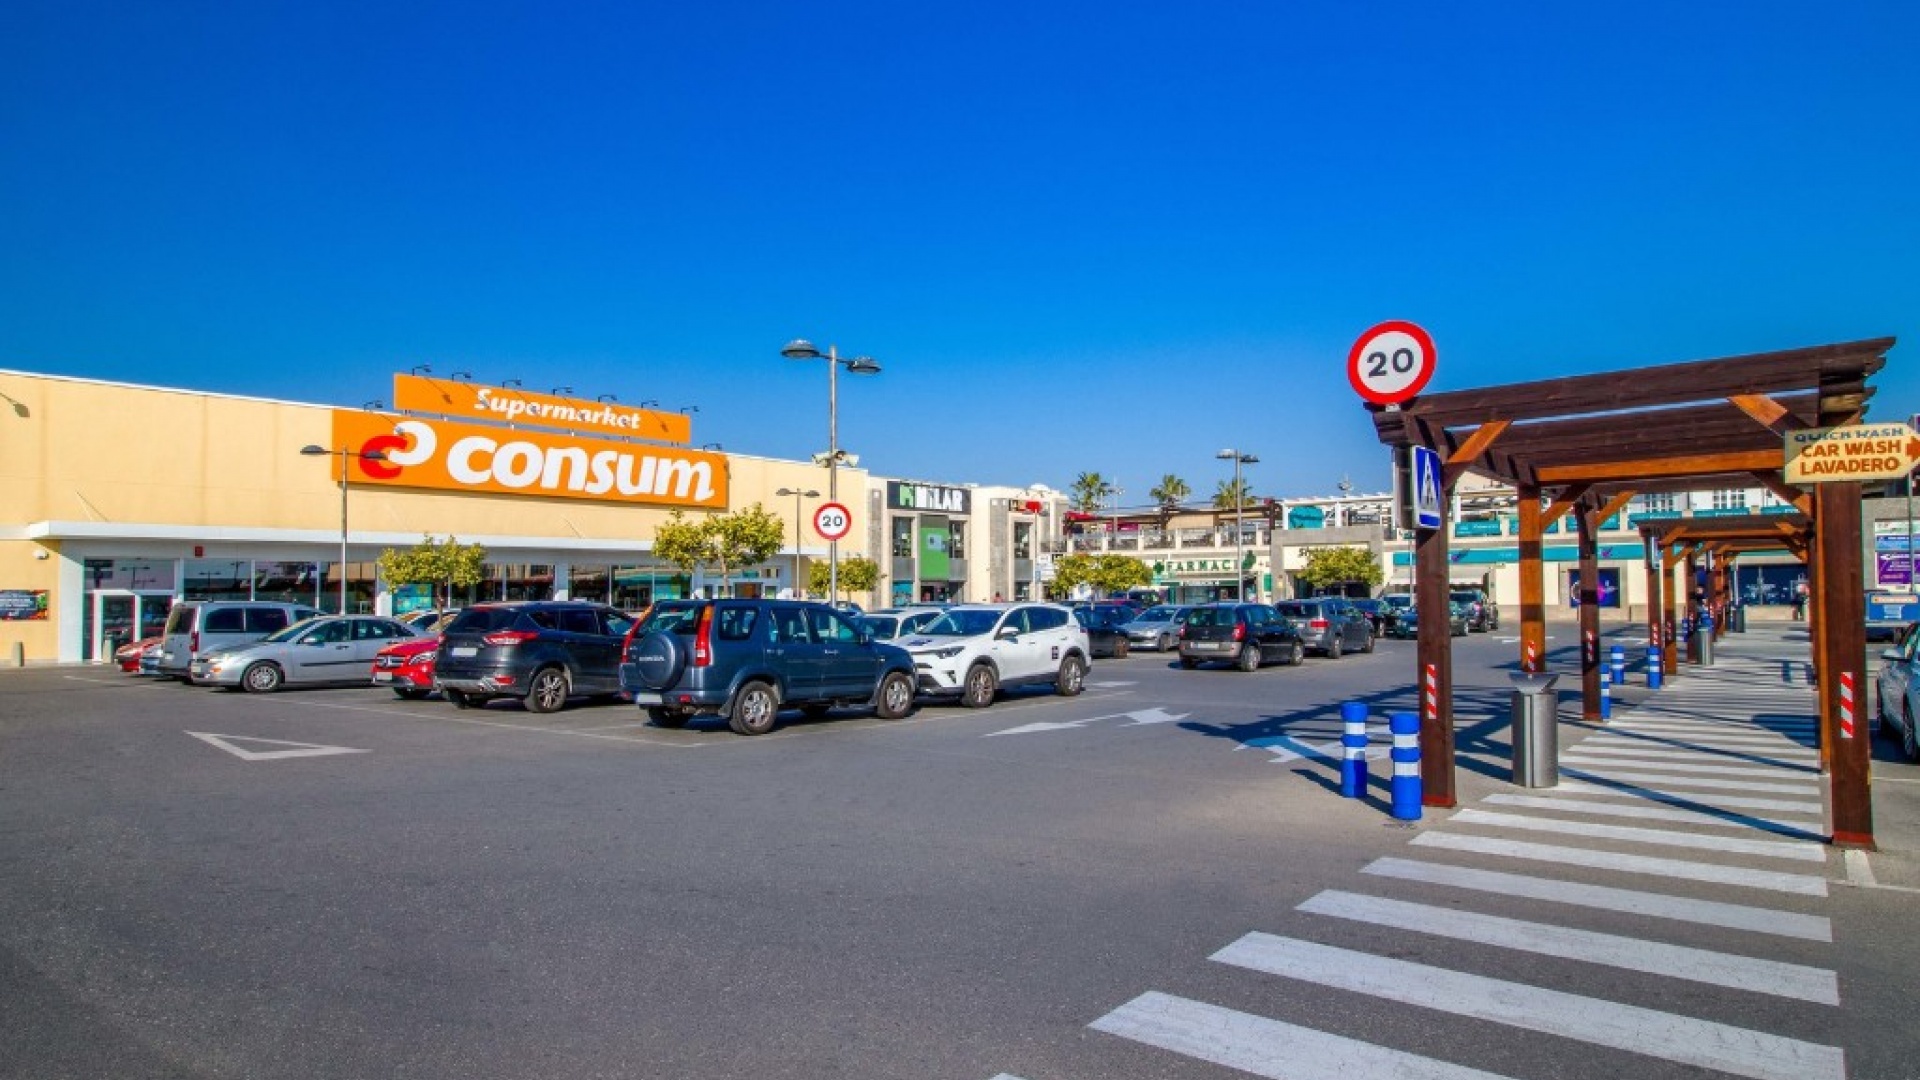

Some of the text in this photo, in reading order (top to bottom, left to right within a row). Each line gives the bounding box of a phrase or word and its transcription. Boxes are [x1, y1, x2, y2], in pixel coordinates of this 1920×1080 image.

[1366, 347, 1415, 378] 20
[474, 388, 640, 430] Supermarket
[1856, 428, 1903, 438] WASH
[1801, 439, 1902, 457] CAR WASH
[446, 435, 715, 501] consum
[1800, 457, 1900, 475] LAVADERO
[822, 514, 843, 528] 20
[1166, 559, 1239, 571] FARMACI
